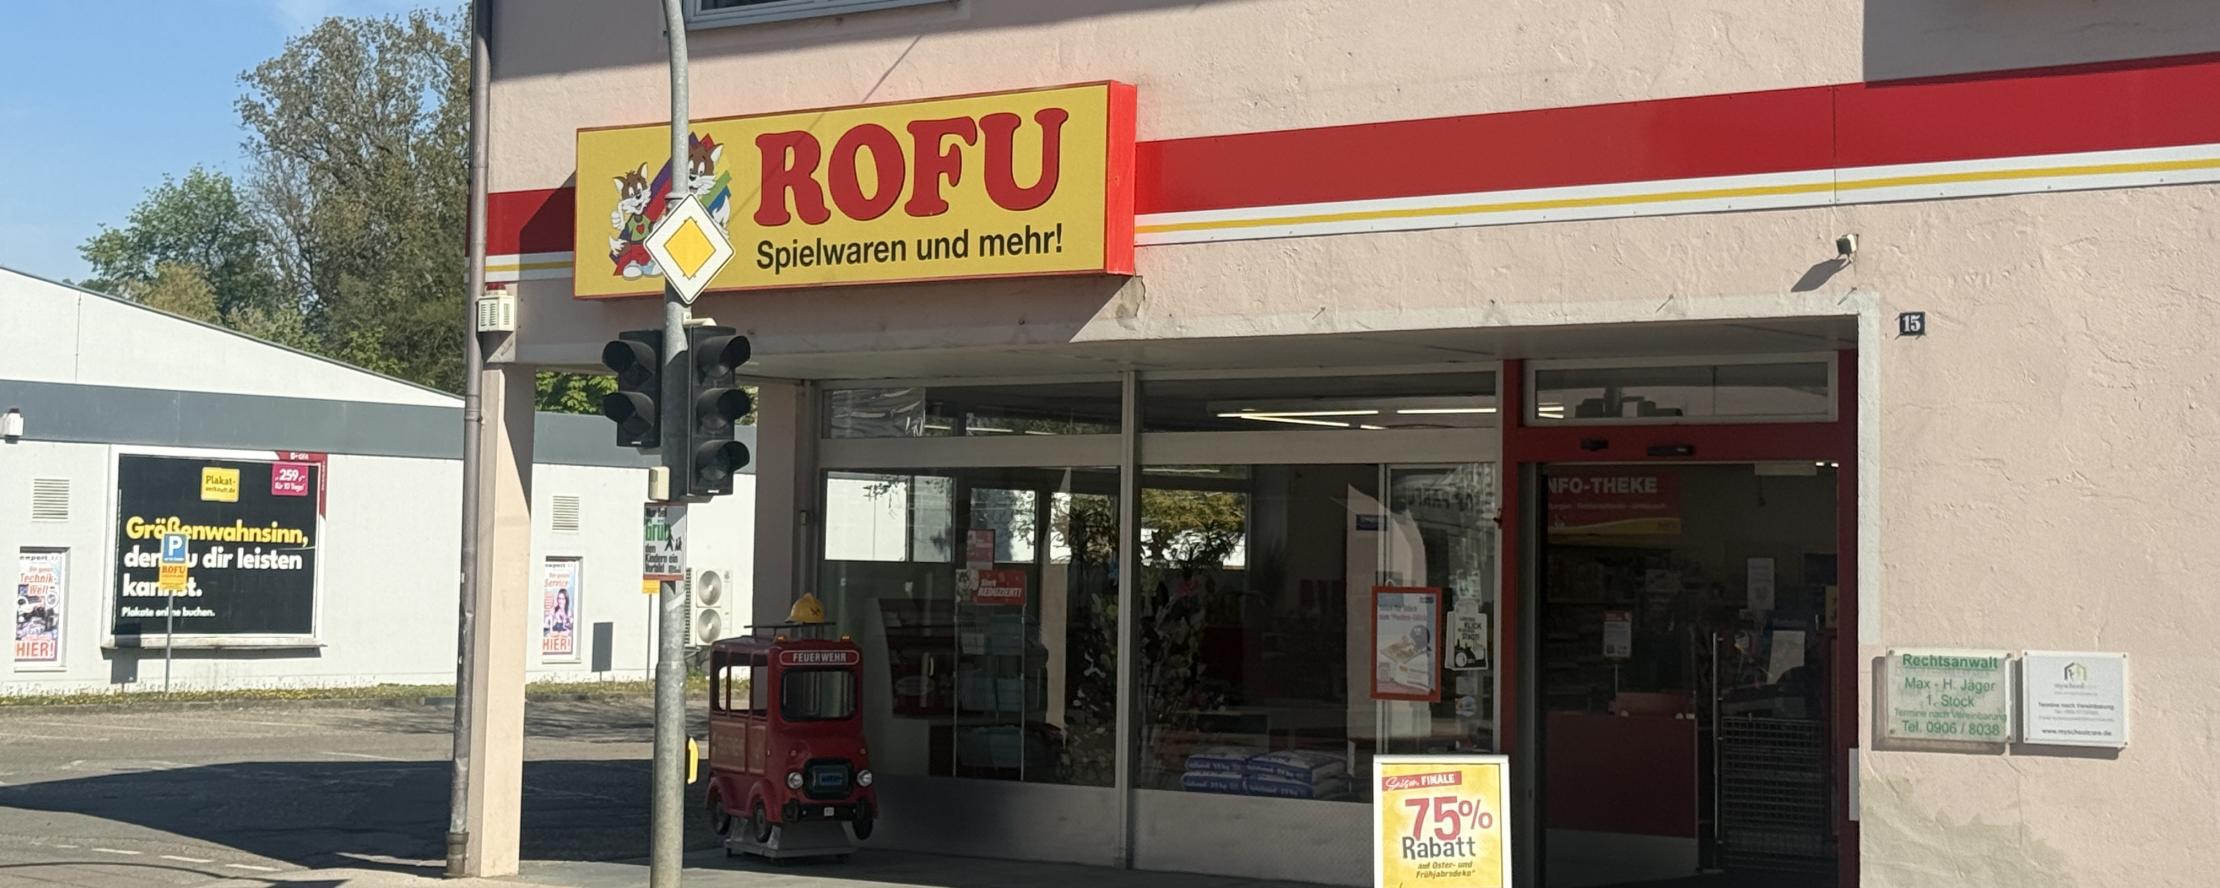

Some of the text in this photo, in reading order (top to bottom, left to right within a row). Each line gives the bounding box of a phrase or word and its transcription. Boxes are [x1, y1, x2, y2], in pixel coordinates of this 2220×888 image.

[753, 107, 1069, 227] ROFU
[756, 223, 1063, 274] Spielwaren und mehr!
[1902, 314, 1921, 332] 15
[205, 475, 236, 485] Plakat-
[1548, 476, 1657, 494] NFO-THEKE
[126, 516, 309, 547] Größenwahnsinn,
[168, 536, 183, 556] P
[202, 546, 233, 569] dir
[237, 547, 302, 570] leisten
[121, 606, 154, 617] Plakate
[155, 606, 181, 617] onlne
[16, 642, 54, 657] HIER!
[543, 639, 571, 651] HIER!
[793, 652, 847, 662] FEUERWEHR
[1902, 653, 1998, 669] Rechtsanwalt
[1904, 677, 1930, 689] Max
[1940, 694, 1975, 707] Stock
[1926, 721, 1957, 734] 0906
[1968, 723, 2000, 736] 8038
[1421, 773, 1455, 786] FINALE
[1405, 796, 1493, 841] 75%
[1402, 837, 1476, 860] Rabatt
[1432, 861, 1455, 869] Oster-
